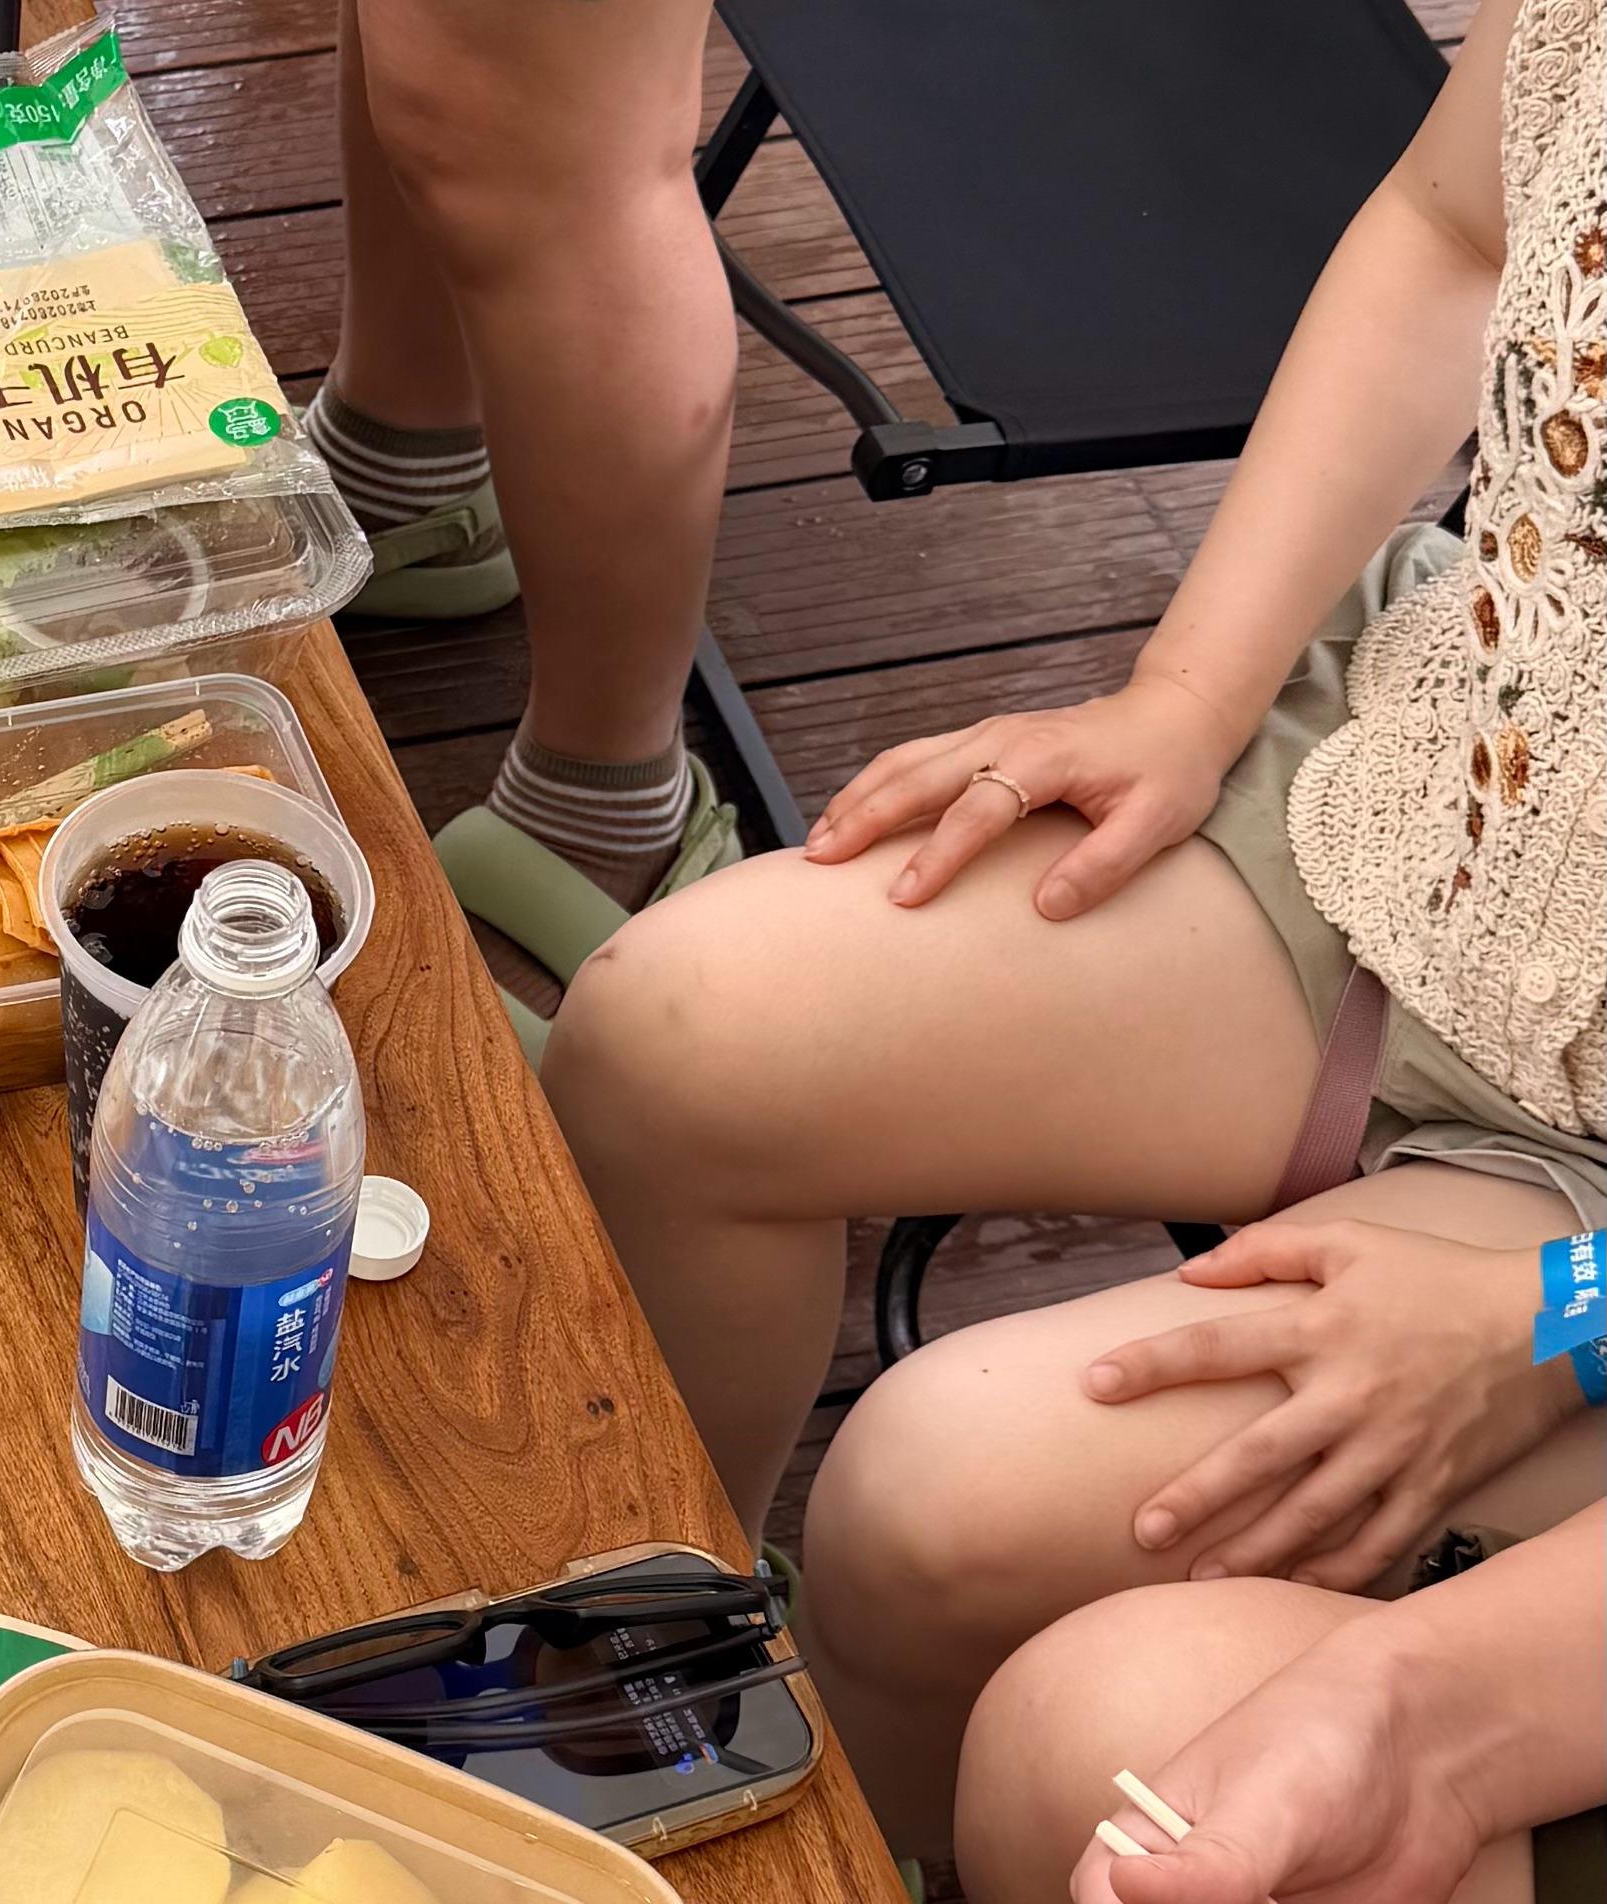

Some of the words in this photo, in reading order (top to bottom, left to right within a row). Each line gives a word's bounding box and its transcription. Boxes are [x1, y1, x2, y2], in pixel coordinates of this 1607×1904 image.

[4, 325, 130, 357] BEANCURD
[270, 1308, 307, 1382] 盐汽水
[267, 1393, 325, 1463] NB
